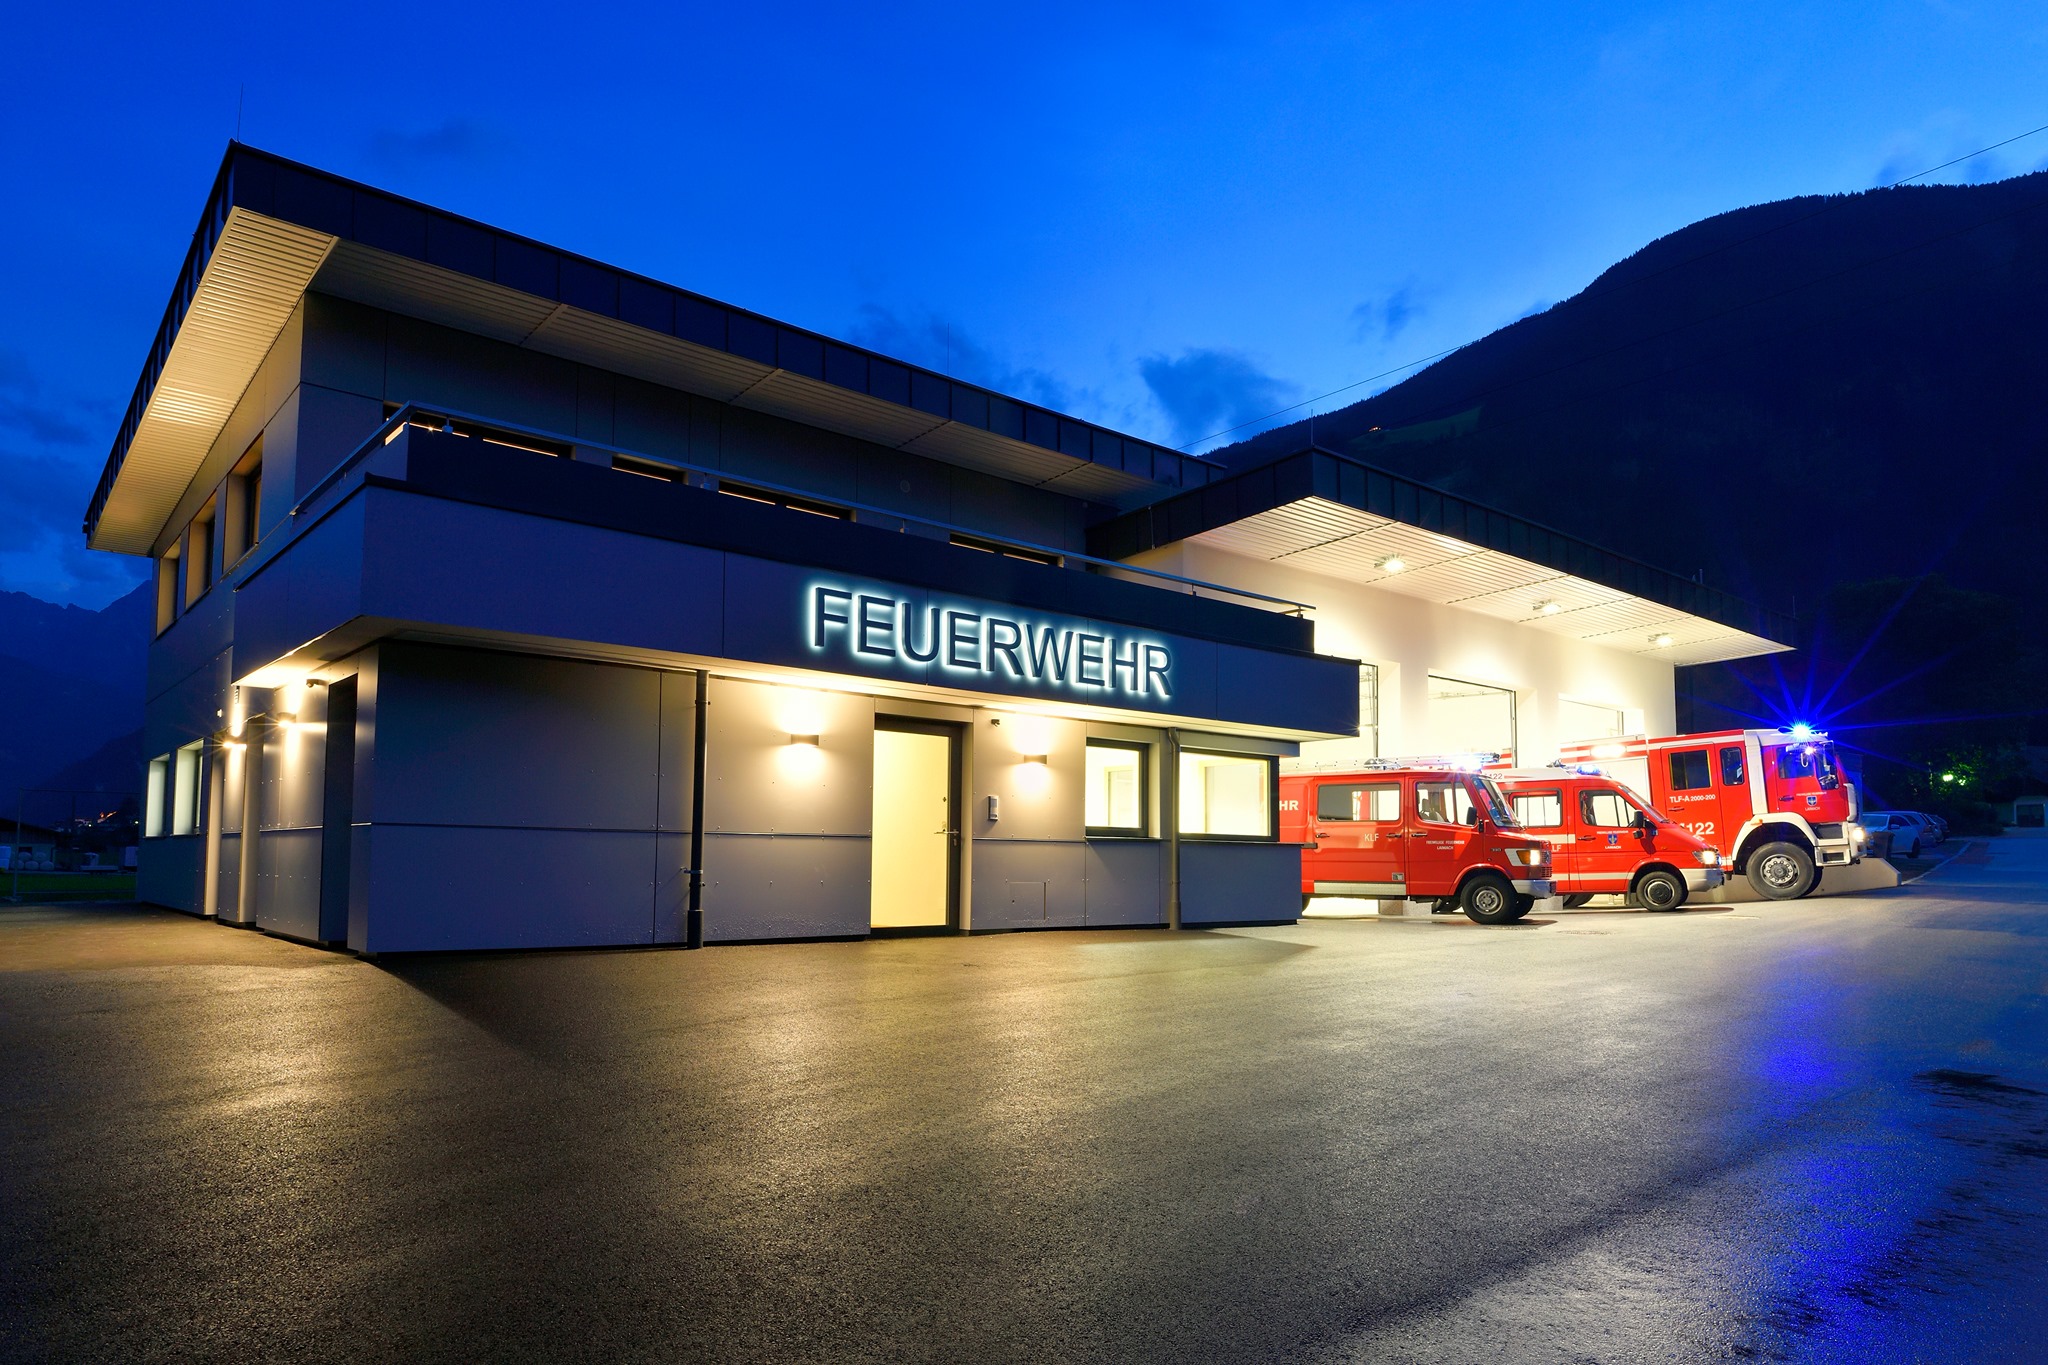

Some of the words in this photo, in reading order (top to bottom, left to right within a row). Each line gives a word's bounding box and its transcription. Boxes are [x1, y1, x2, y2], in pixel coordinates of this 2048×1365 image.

[814, 587, 1172, 696] FEUERWEHR
[1669, 795, 1690, 803] TLF-A
[1364, 833, 1379, 842] KLF
